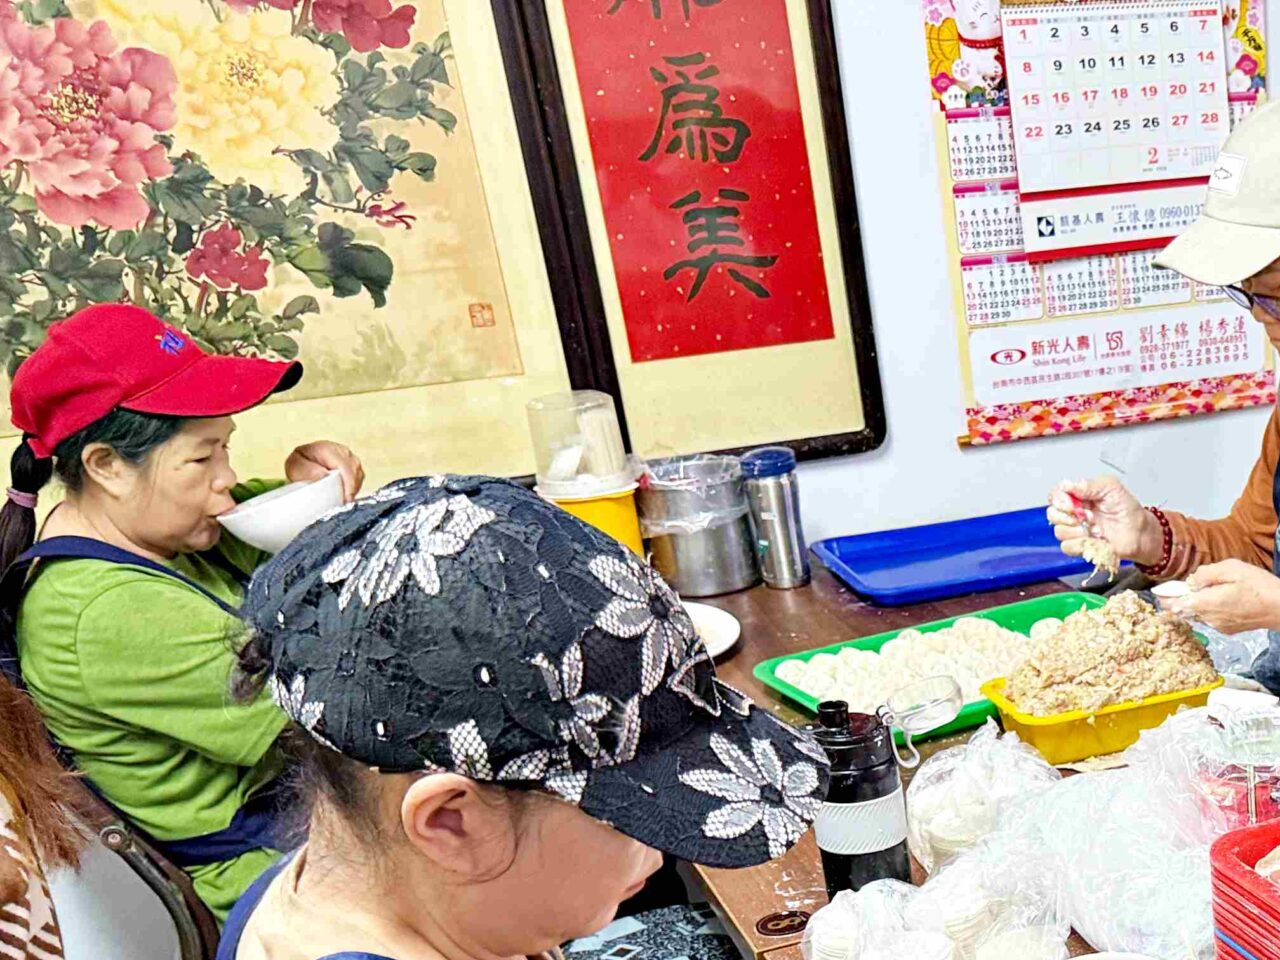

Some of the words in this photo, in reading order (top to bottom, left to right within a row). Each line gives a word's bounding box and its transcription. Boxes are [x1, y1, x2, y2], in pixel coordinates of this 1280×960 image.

[1020, 29, 1026, 40] 1
[1051, 28, 1059, 38] 2
[1081, 26, 1089, 36] 3
[1110, 24, 1119, 34] 4
[1141, 23, 1149, 33] 5
[1170, 22, 1178, 32] 6
[1200, 20, 1207, 30] 7
[1023, 62, 1032, 72] 8
[1054, 60, 1062, 70] 9
[1080, 58, 1096, 68] 10
[1109, 56, 1124, 67] 11
[1139, 55, 1155, 65] 12
[1168, 53, 1184, 63] 13
[1198, 51, 1214, 61] 14
[1022, 94, 1040, 105] 15
[1053, 92, 1070, 103] 16
[1082, 90, 1098, 101] 17
[1112, 88, 1128, 98] 18
[1141, 86, 1157, 96] 19
[1170, 84, 1186, 95] 20
[1200, 82, 1215, 93] 21
[1025, 126, 1043, 138] 22
[1056, 124, 1072, 135] 23
[1084, 122, 1101, 132] 24
[1114, 120, 1130, 130] 25
[1143, 118, 1160, 128] 26
[1172, 115, 1188, 126] 27
[1202, 113, 1218, 124] 28
[964, 135, 969, 143] 5
[963, 146, 972, 154] 12
[1147, 147, 1159, 164] 2
[964, 157, 974, 166] 19
[976, 156, 985, 164] 20
[965, 168, 975, 176] 26
[1159, 203, 1205, 219] 0960-013
[1031, 335, 1090, 356] 新光人壽
